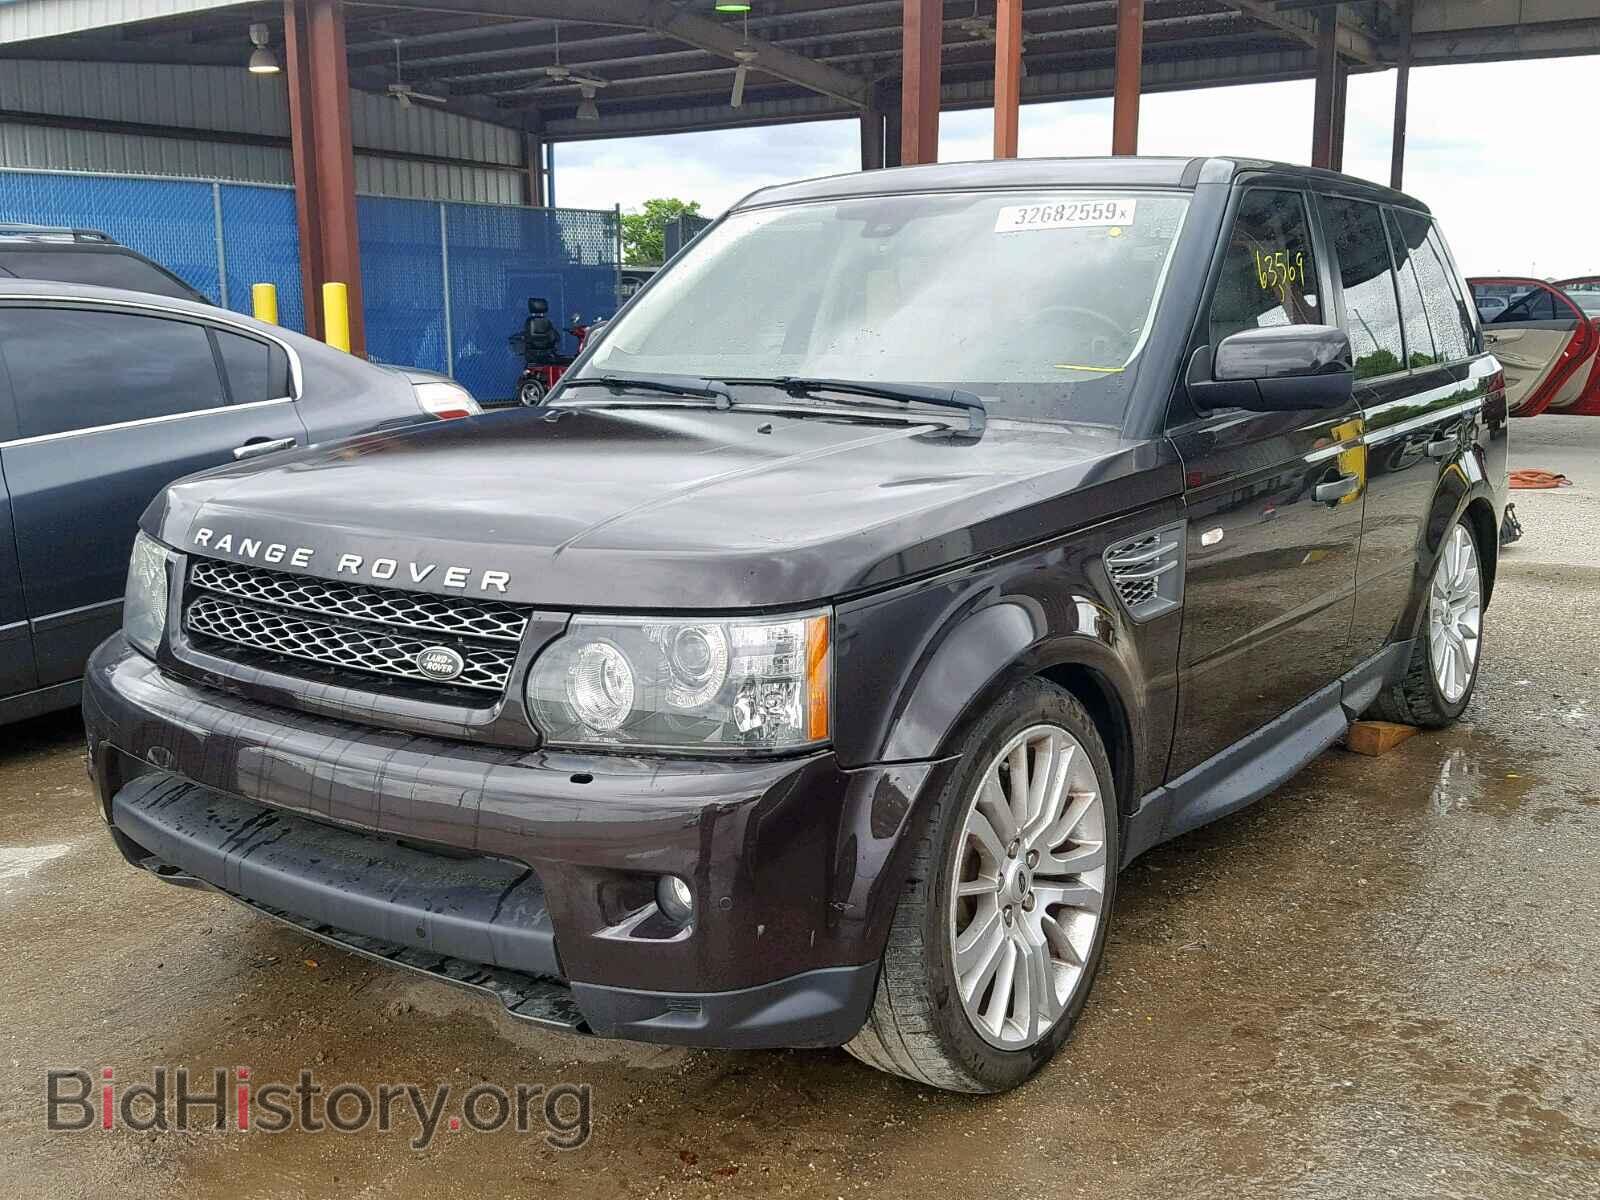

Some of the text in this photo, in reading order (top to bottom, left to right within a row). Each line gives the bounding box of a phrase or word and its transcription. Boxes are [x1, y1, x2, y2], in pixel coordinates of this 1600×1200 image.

[1256, 249, 1305, 289] 63569
[194, 527, 511, 593] RANGE ROVER
